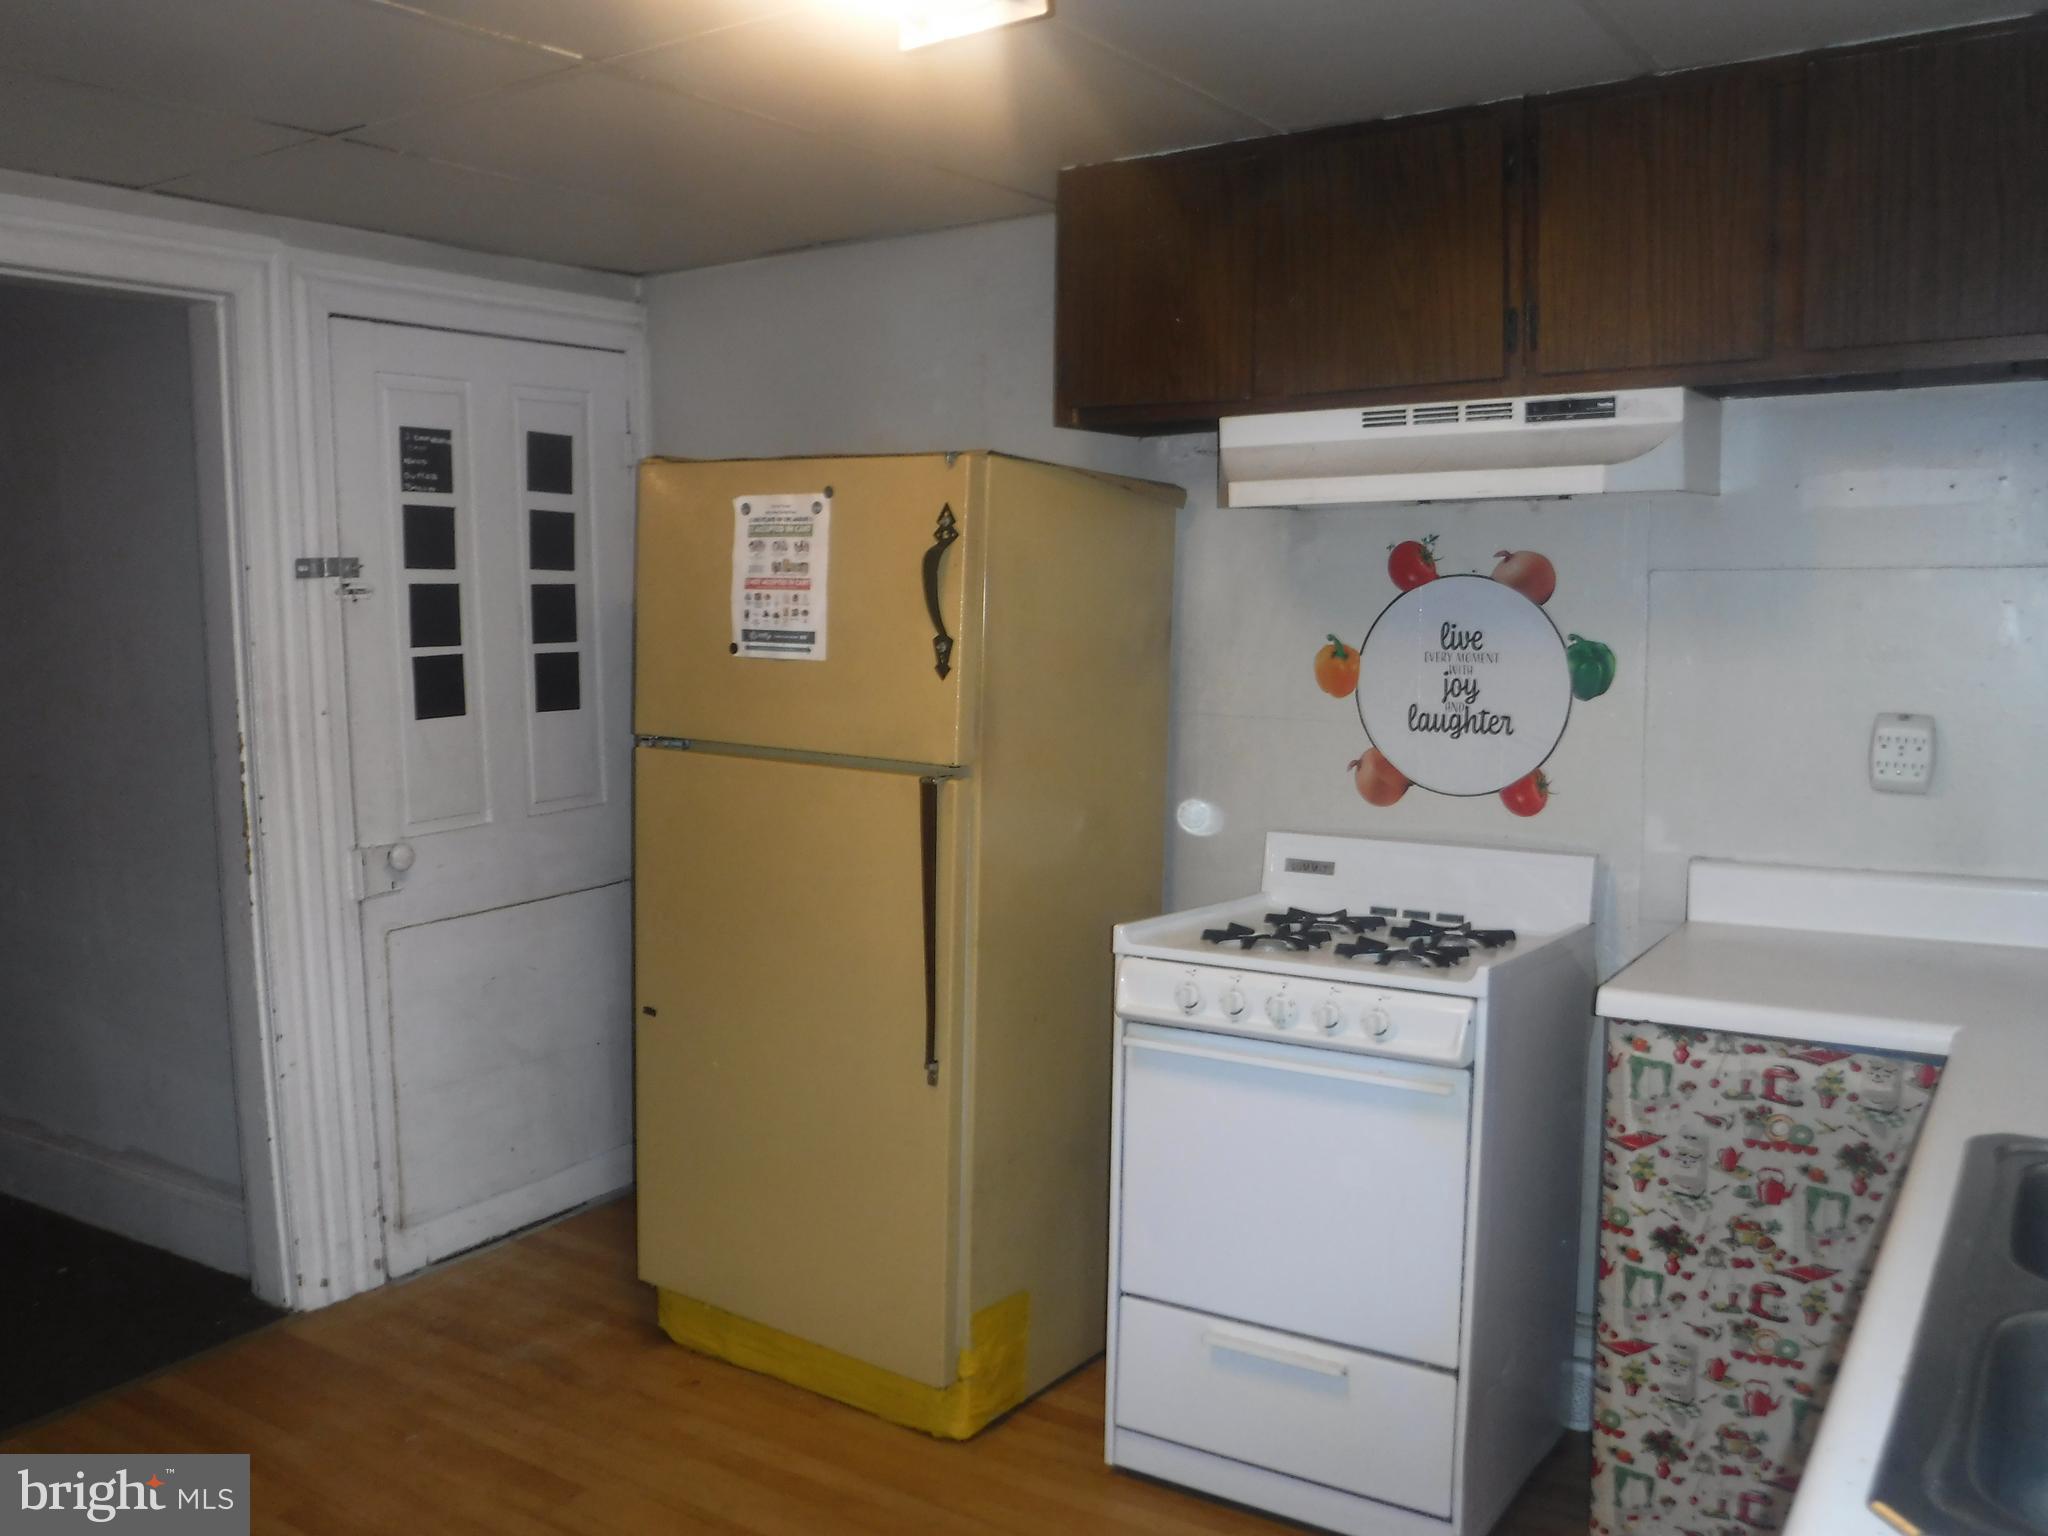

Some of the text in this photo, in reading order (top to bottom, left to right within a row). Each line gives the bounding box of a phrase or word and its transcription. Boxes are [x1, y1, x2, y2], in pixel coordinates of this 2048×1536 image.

[1440, 621, 1483, 651] live
[1424, 651, 1499, 664] EVERY MOMENT
[1447, 664, 1473, 676] WITH
[1441, 670, 1480, 705] joy
[1445, 701, 1465, 713] AND
[1407, 703, 1515, 740] laughter
